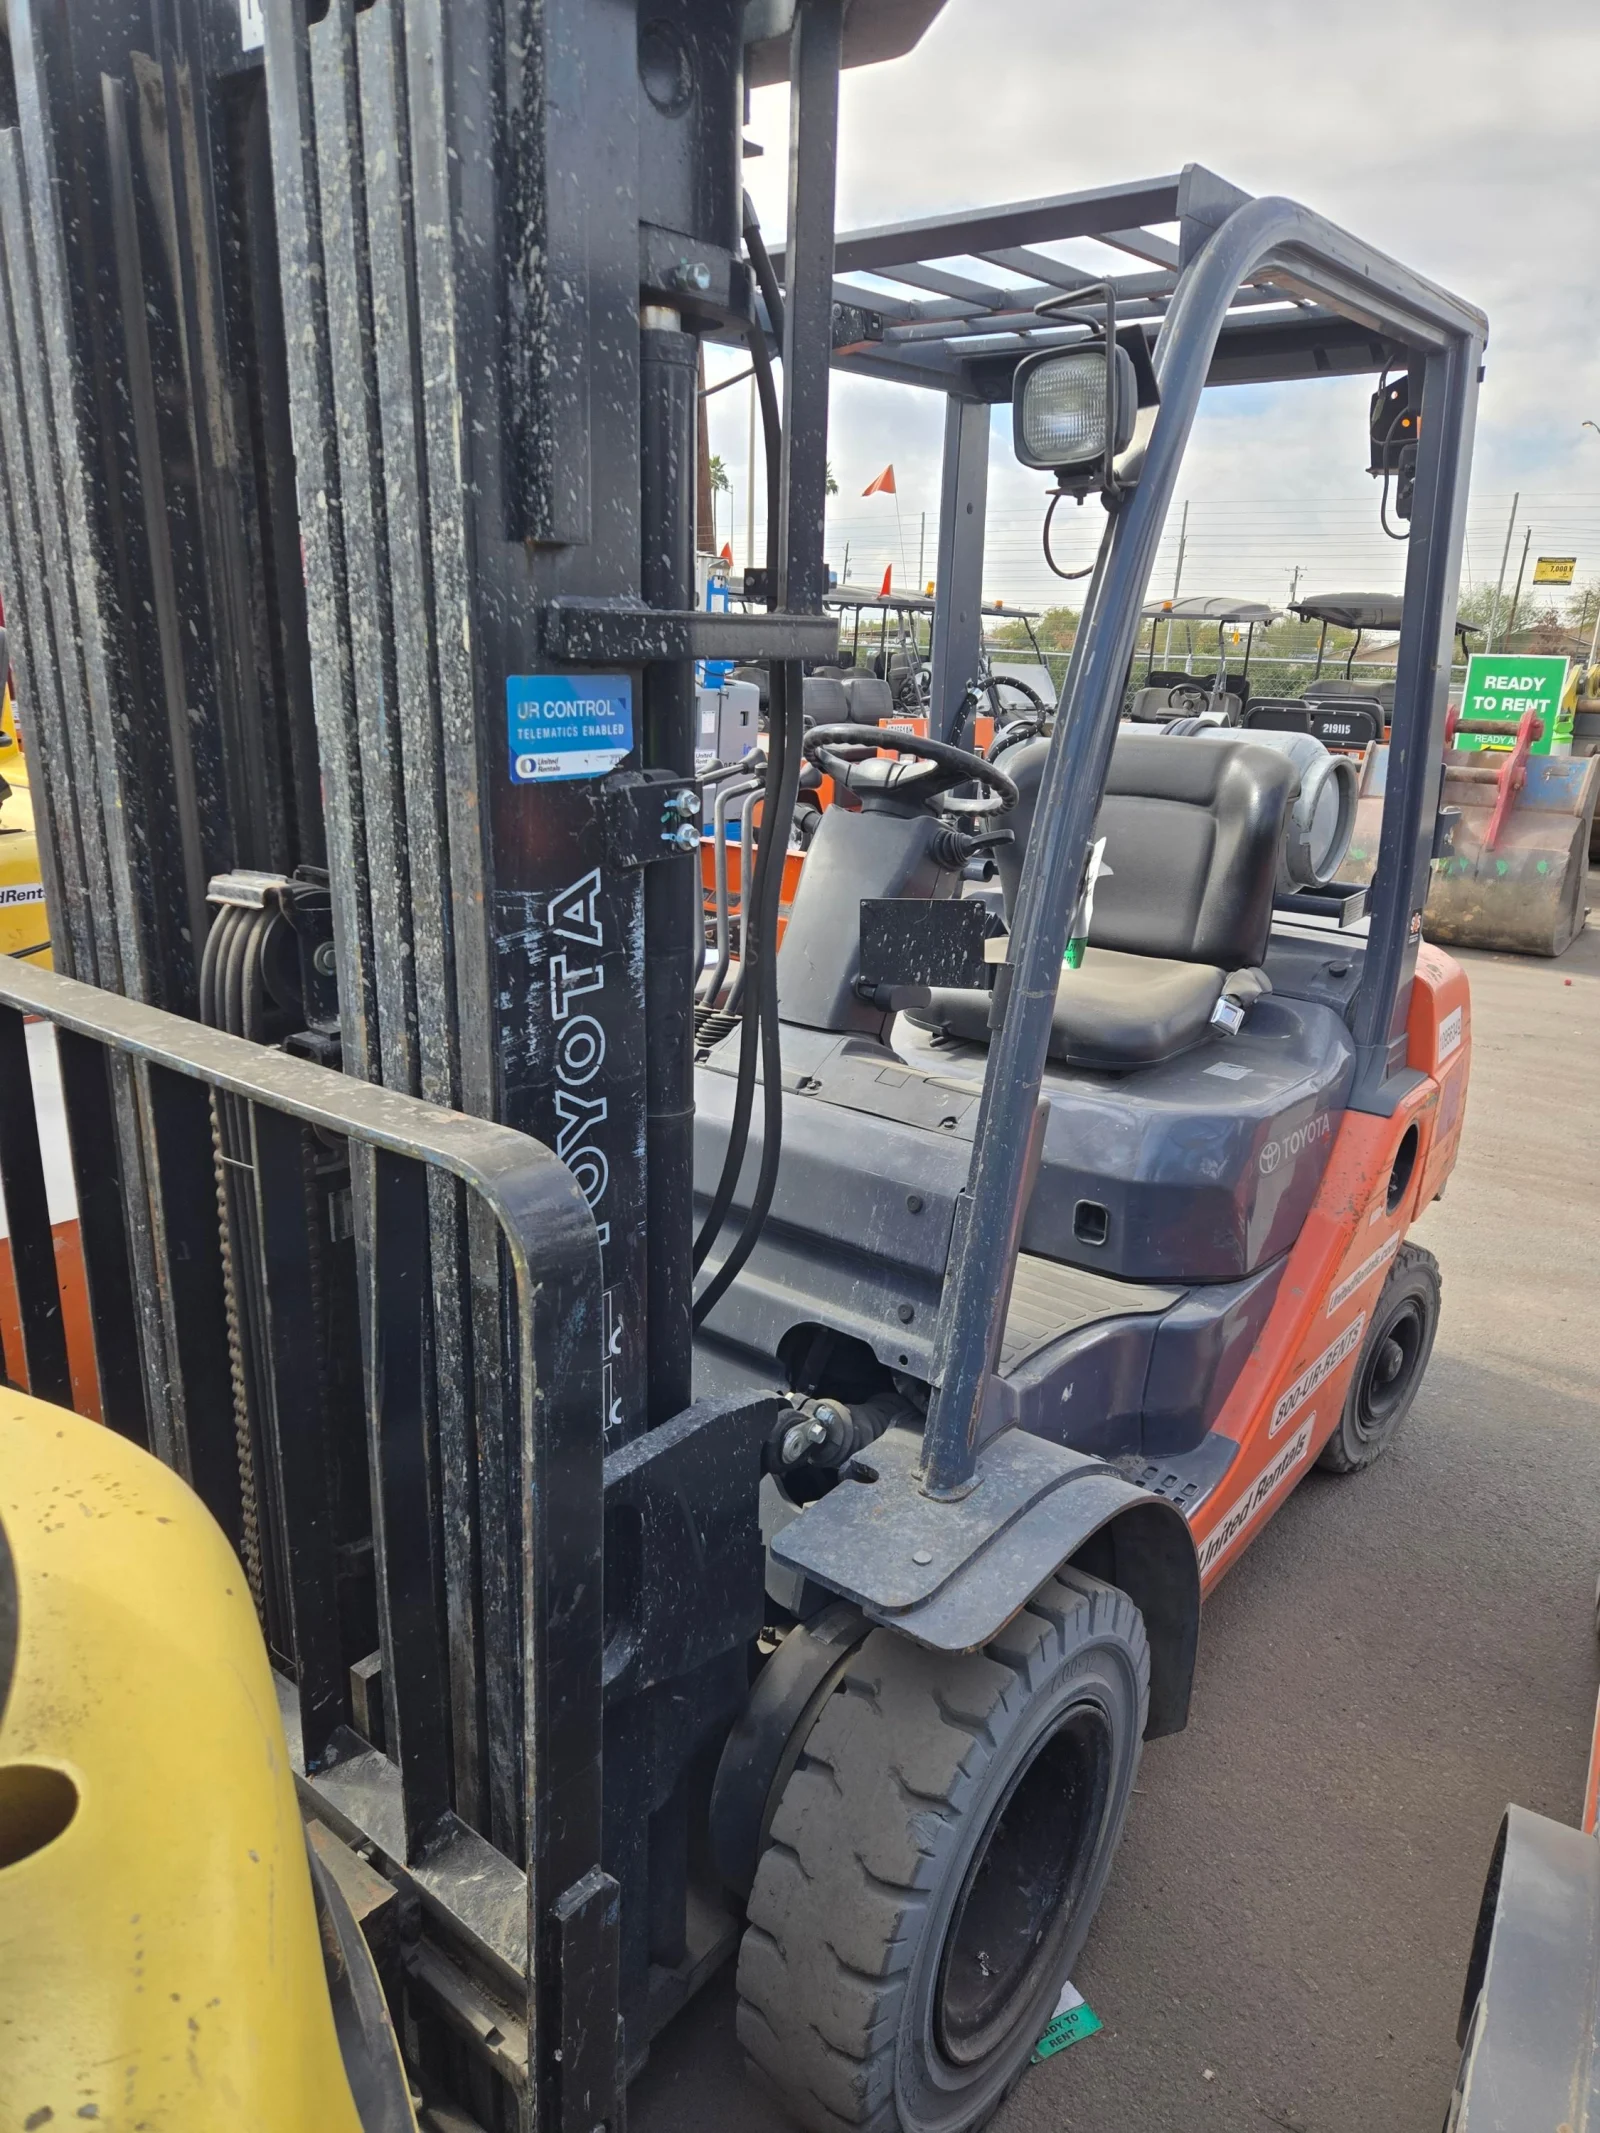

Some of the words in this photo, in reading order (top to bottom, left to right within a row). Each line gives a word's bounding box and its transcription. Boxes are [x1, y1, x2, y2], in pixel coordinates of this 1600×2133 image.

[1484, 675, 1546, 691] READY
[517, 701, 540, 719] UR
[543, 699, 615, 718] CONTROL
[1473, 696, 1497, 710] TO
[1501, 697, 1551, 713] RENT
[517, 726, 578, 740] TELEMATICS
[582, 723, 625, 736] ENABLED
[1322, 723, 1351, 734] 219115
[1474, 734, 1508, 744] READY
[537, 757, 559, 765] United
[548, 867, 610, 1244] OYOTA
[1281, 1112, 1330, 1159] TOYOTA
[1275, 1324, 1361, 1427] 800-UR-RENTS
[1199, 1497, 1254, 1570] United
[1252, 1432, 1308, 1510] Rentals
[1041, 2021, 1064, 2038] ADY
[1064, 2013, 1079, 2025] TO
[1049, 2029, 1076, 2047] RENT
